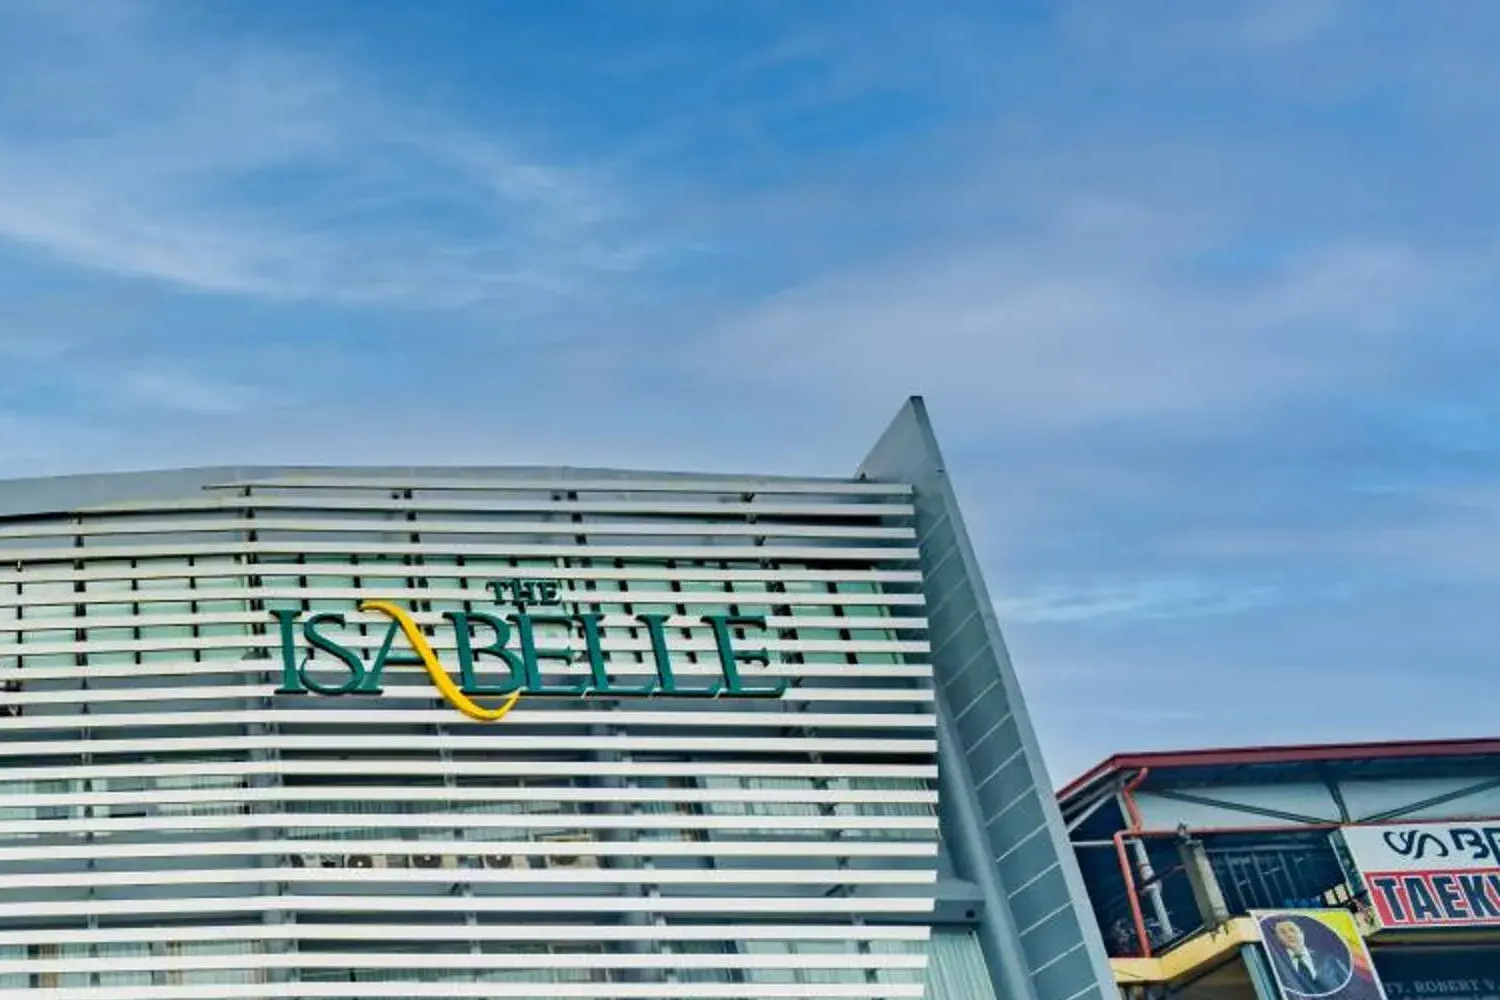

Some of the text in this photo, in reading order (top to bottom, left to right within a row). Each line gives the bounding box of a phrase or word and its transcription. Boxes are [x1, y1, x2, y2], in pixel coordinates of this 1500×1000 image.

[486, 577, 562, 607] THE
[269, 600, 788, 721] ISABELLE
[1413, 978, 1480, 994] ROBERT
